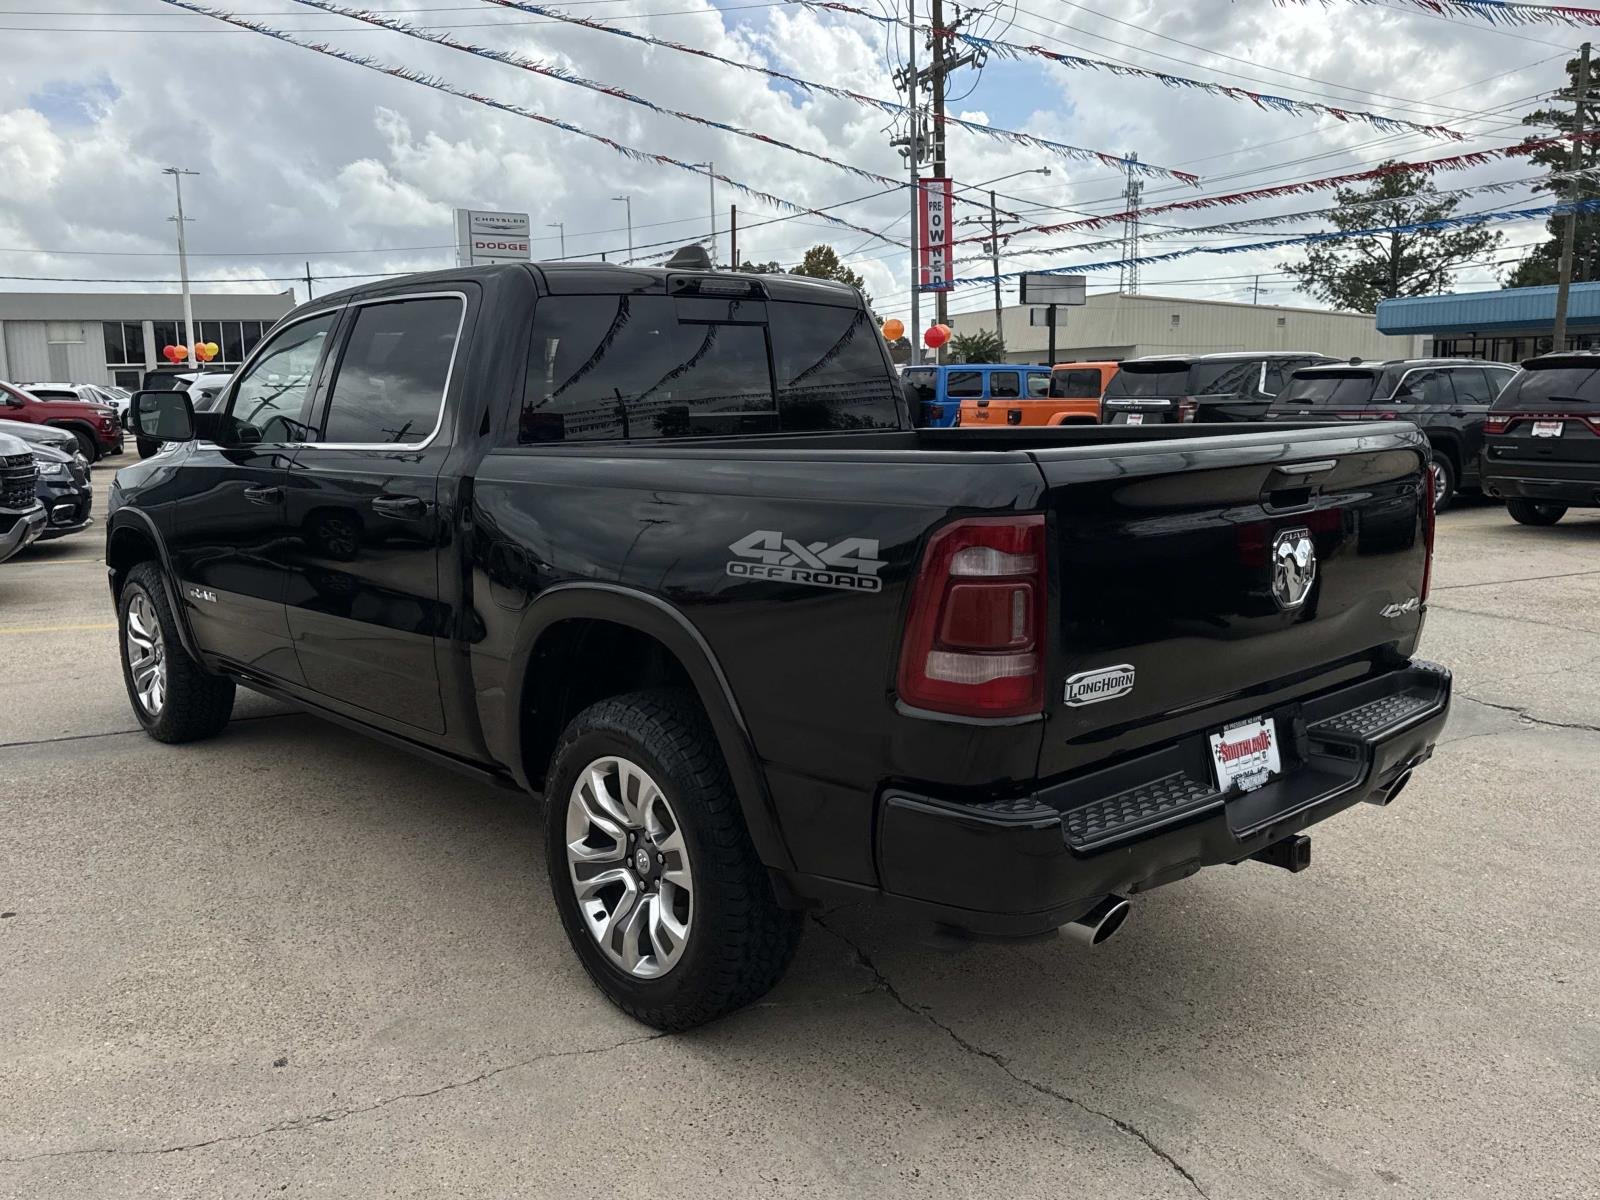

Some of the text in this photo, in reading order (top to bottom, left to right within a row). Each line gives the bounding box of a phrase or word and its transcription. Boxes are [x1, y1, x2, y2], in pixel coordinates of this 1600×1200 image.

[928, 201, 944, 212] PRE-
[475, 216, 525, 224] CHRYSLER
[475, 241, 528, 251] DODGE
[1284, 529, 1309, 541] RAM
[729, 563, 879, 590] OFF ROAD
[1219, 730, 1269, 763] SOUTHLAND
